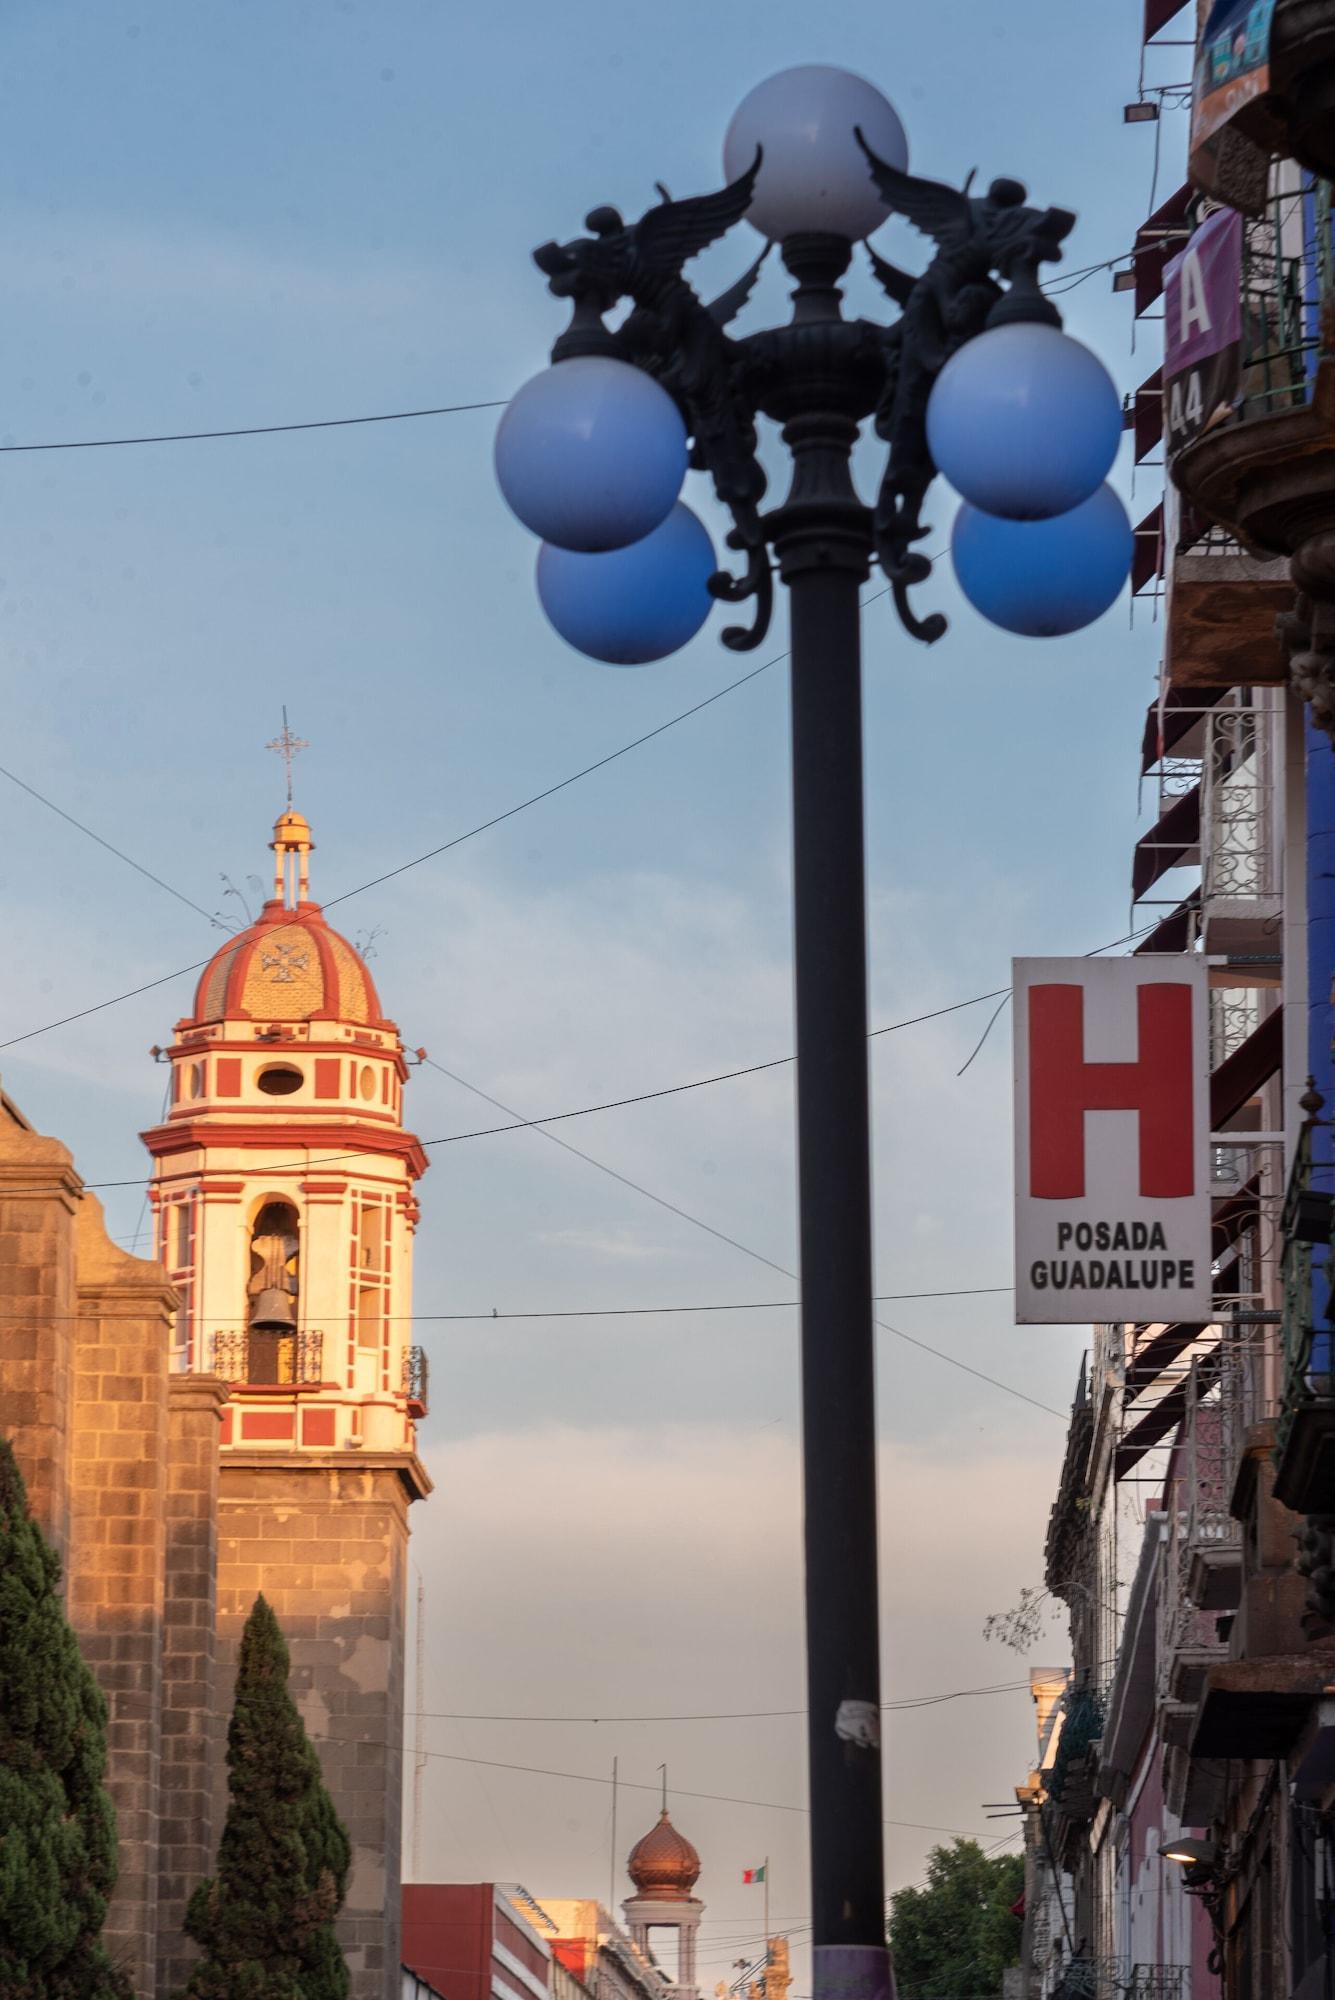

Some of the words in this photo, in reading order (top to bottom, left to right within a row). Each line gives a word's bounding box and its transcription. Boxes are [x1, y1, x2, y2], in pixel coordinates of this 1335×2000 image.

[1180, 247, 1212, 344] A
[1170, 371, 1203, 435] 44
[1028, 982, 1195, 1199] H
[1057, 1221, 1168, 1251] POSADA
[1030, 1259, 1195, 1290] GUADALUPE
